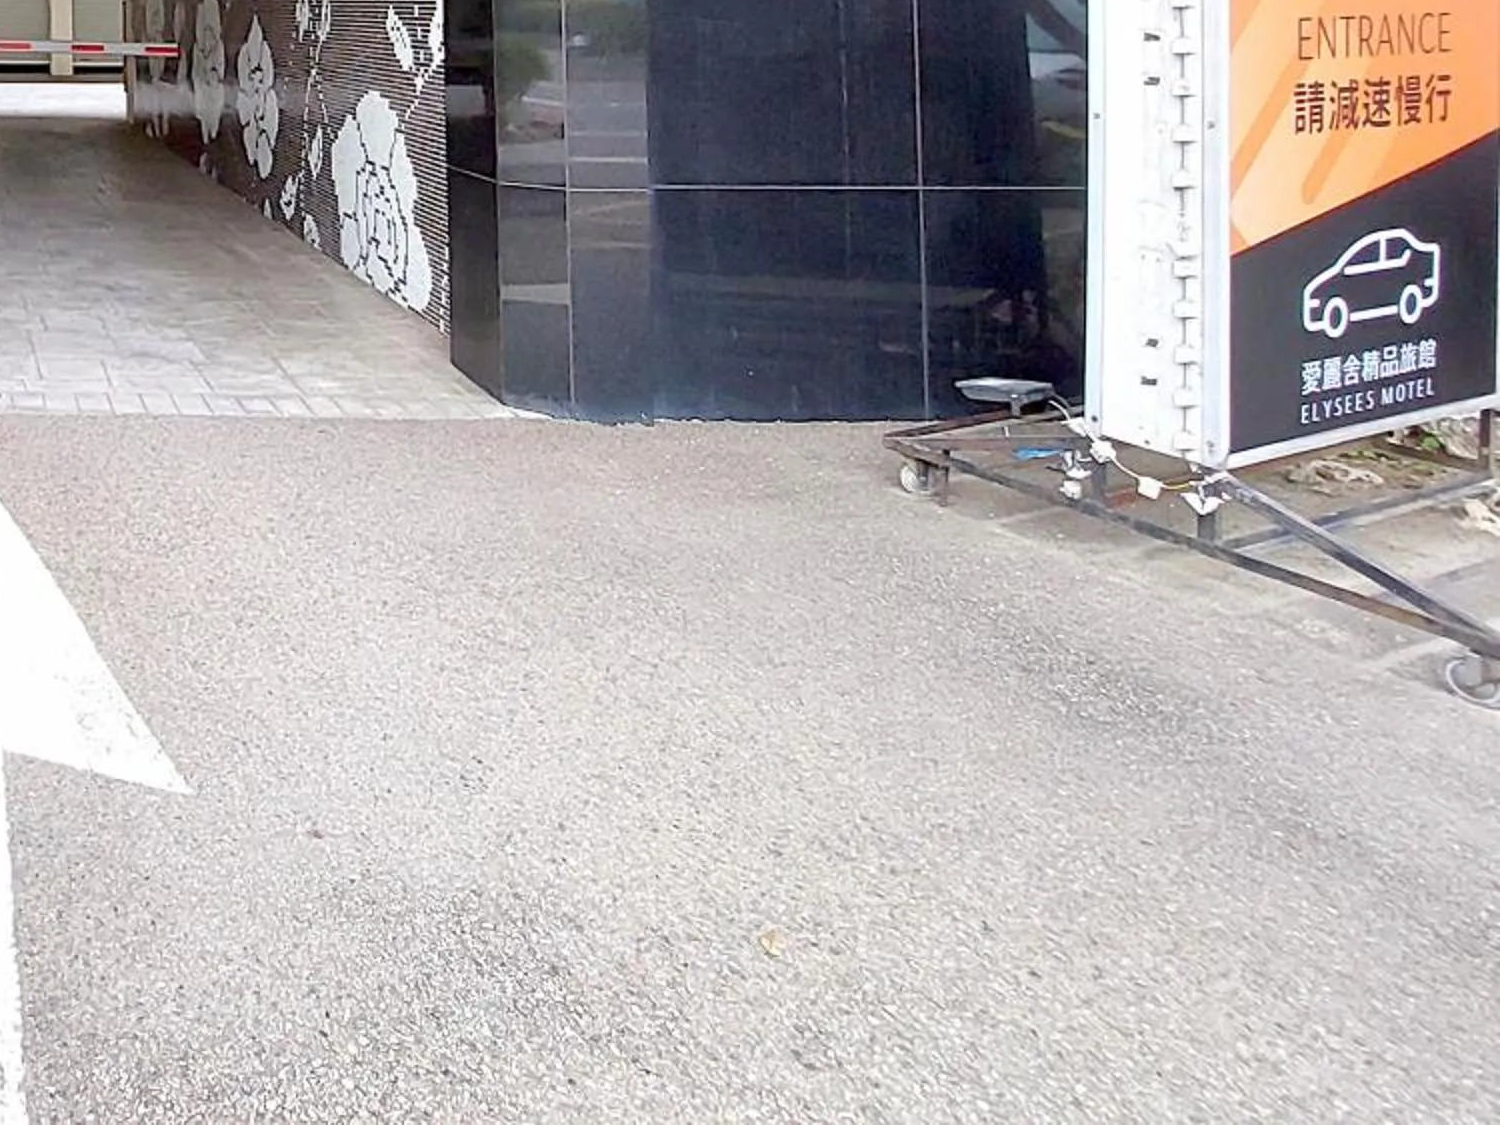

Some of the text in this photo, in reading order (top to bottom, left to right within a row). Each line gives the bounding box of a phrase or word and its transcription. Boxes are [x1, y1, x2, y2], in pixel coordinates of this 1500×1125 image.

[1298, 12, 1452, 60] ENTRANCE
[1293, 73, 1452, 136] 請減速慢行
[1300, 376, 1435, 424] ELYSEES MOTEL
